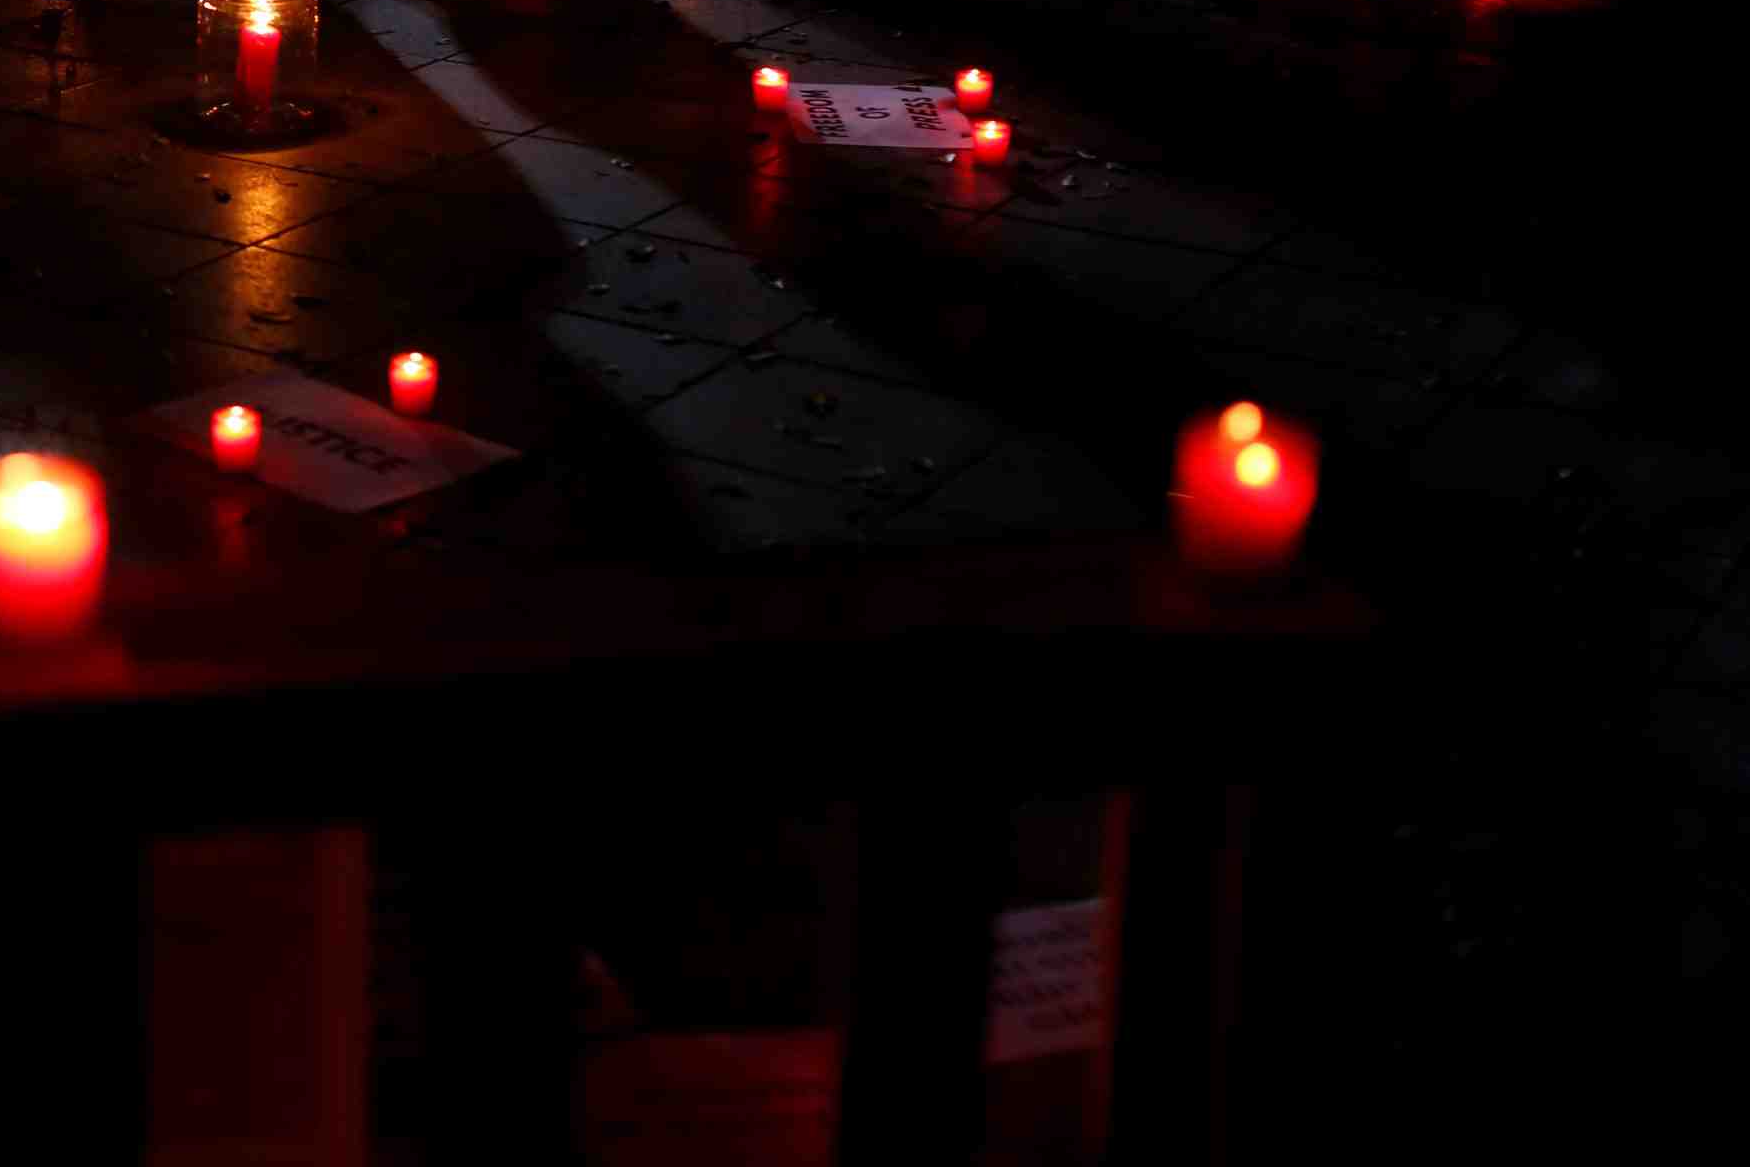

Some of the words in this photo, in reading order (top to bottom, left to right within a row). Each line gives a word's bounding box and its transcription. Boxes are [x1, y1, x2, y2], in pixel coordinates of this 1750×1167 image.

[800, 89, 849, 137] FREEDOM
[854, 106, 890, 120] OF
[901, 96, 947, 132] PRESS
